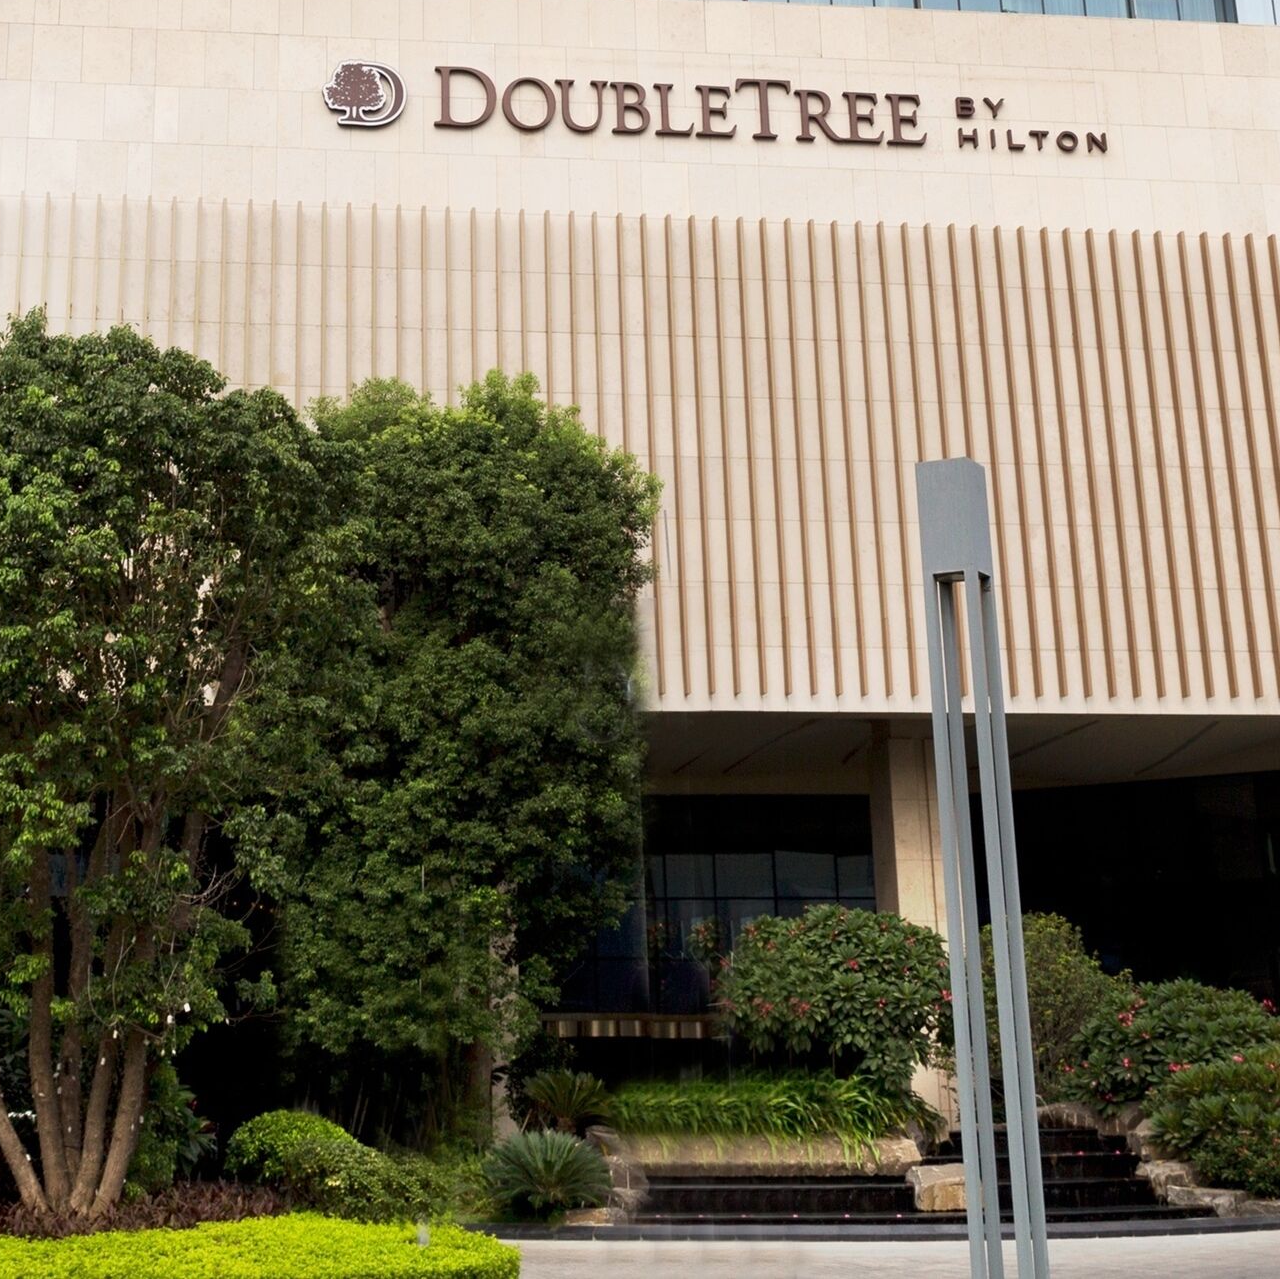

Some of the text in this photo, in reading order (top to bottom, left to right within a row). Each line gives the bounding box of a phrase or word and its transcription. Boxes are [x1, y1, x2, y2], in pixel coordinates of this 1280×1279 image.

[432, 65, 928, 150] DOUBLETREE
[954, 96, 1006, 120] BY
[957, 127, 1109, 155] HILTON
